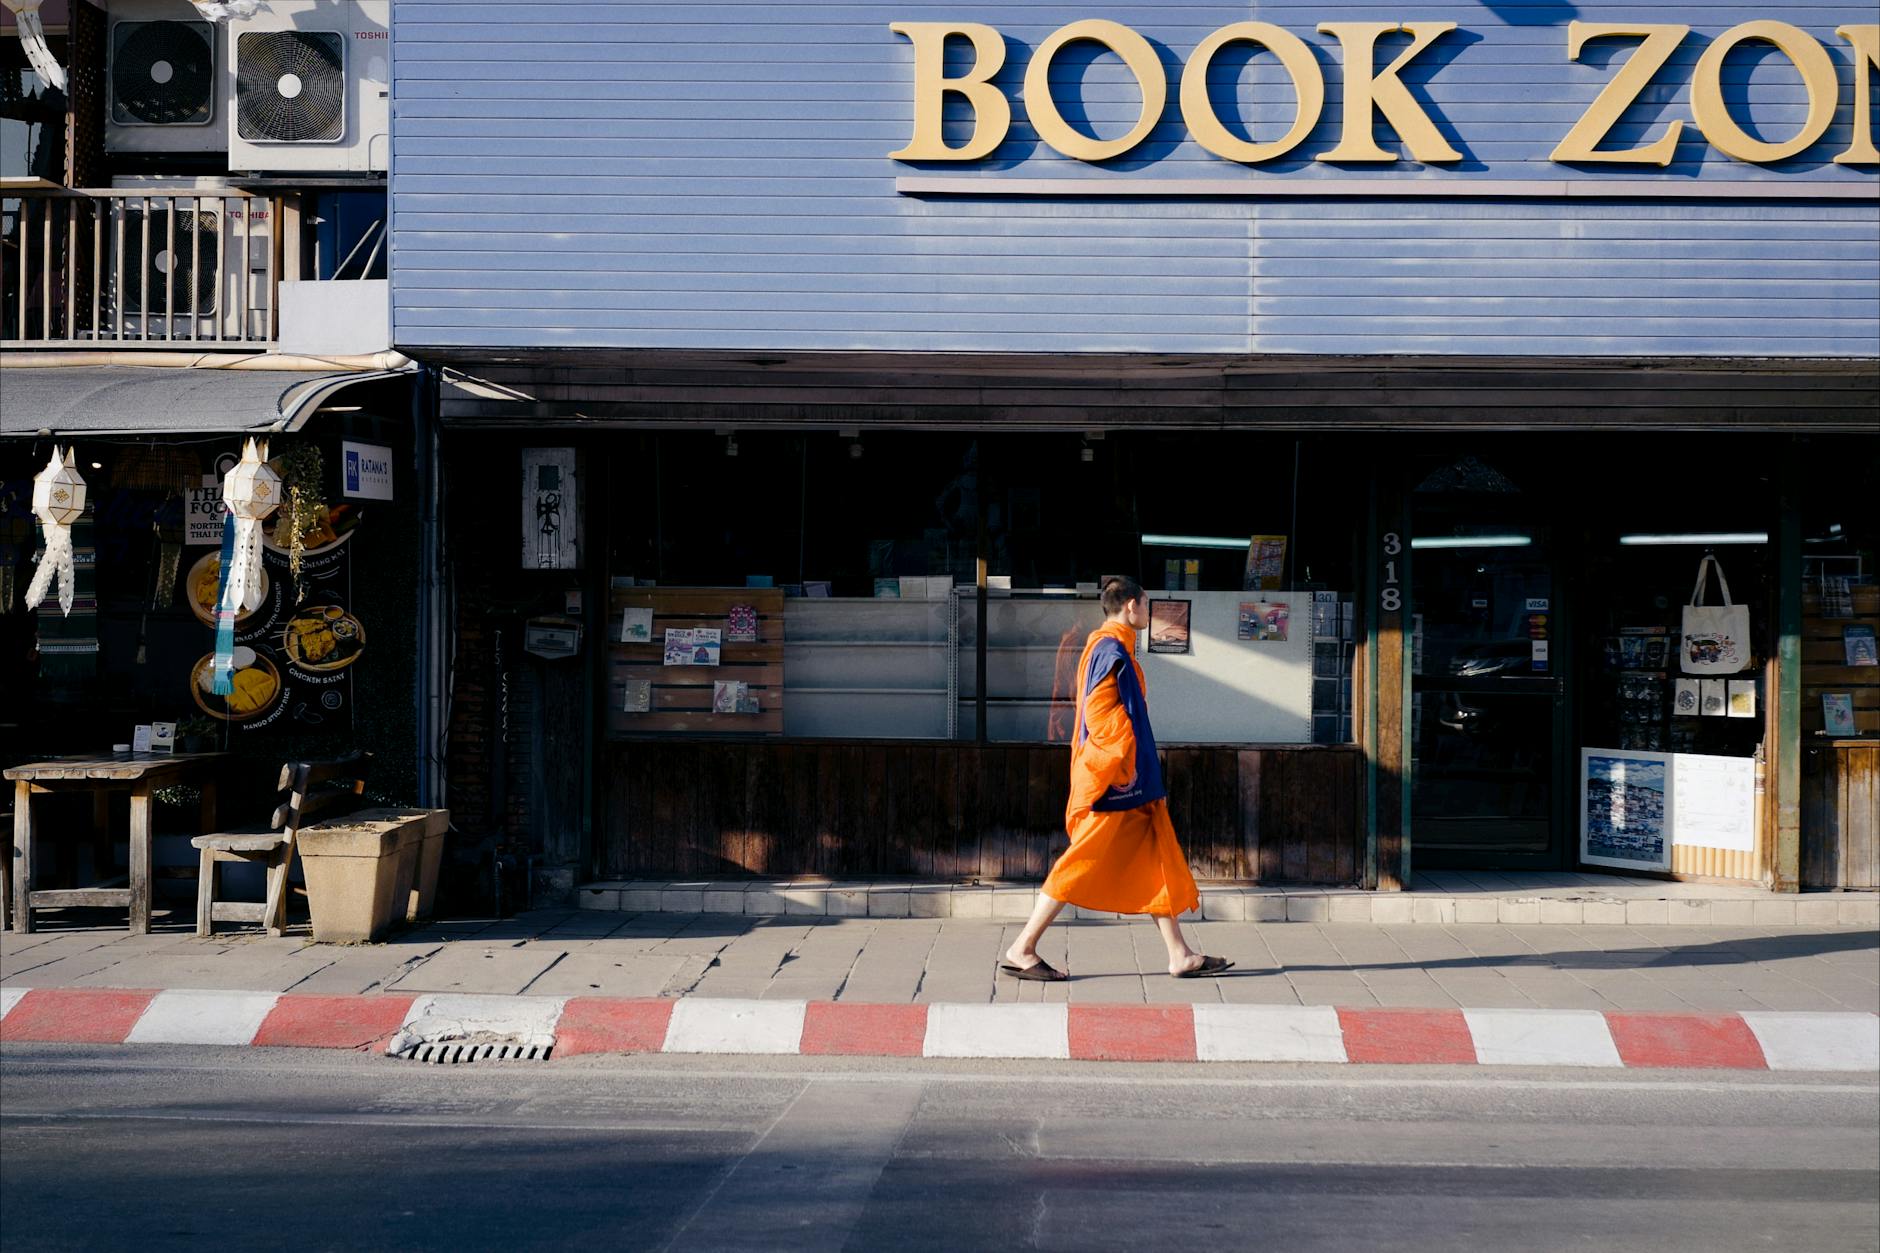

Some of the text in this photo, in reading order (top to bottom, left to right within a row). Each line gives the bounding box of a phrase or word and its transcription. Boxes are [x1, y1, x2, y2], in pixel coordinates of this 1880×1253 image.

[888, 18, 1464, 164] BOOK
[361, 458, 388, 475] RATANA'S
[209, 512, 218, 521] &
[1381, 532, 1402, 611] 318
[1528, 600, 1547, 608] VISA
[289, 667, 345, 684] CHICKEN SATAY
[242, 719, 268, 731] MANGO
